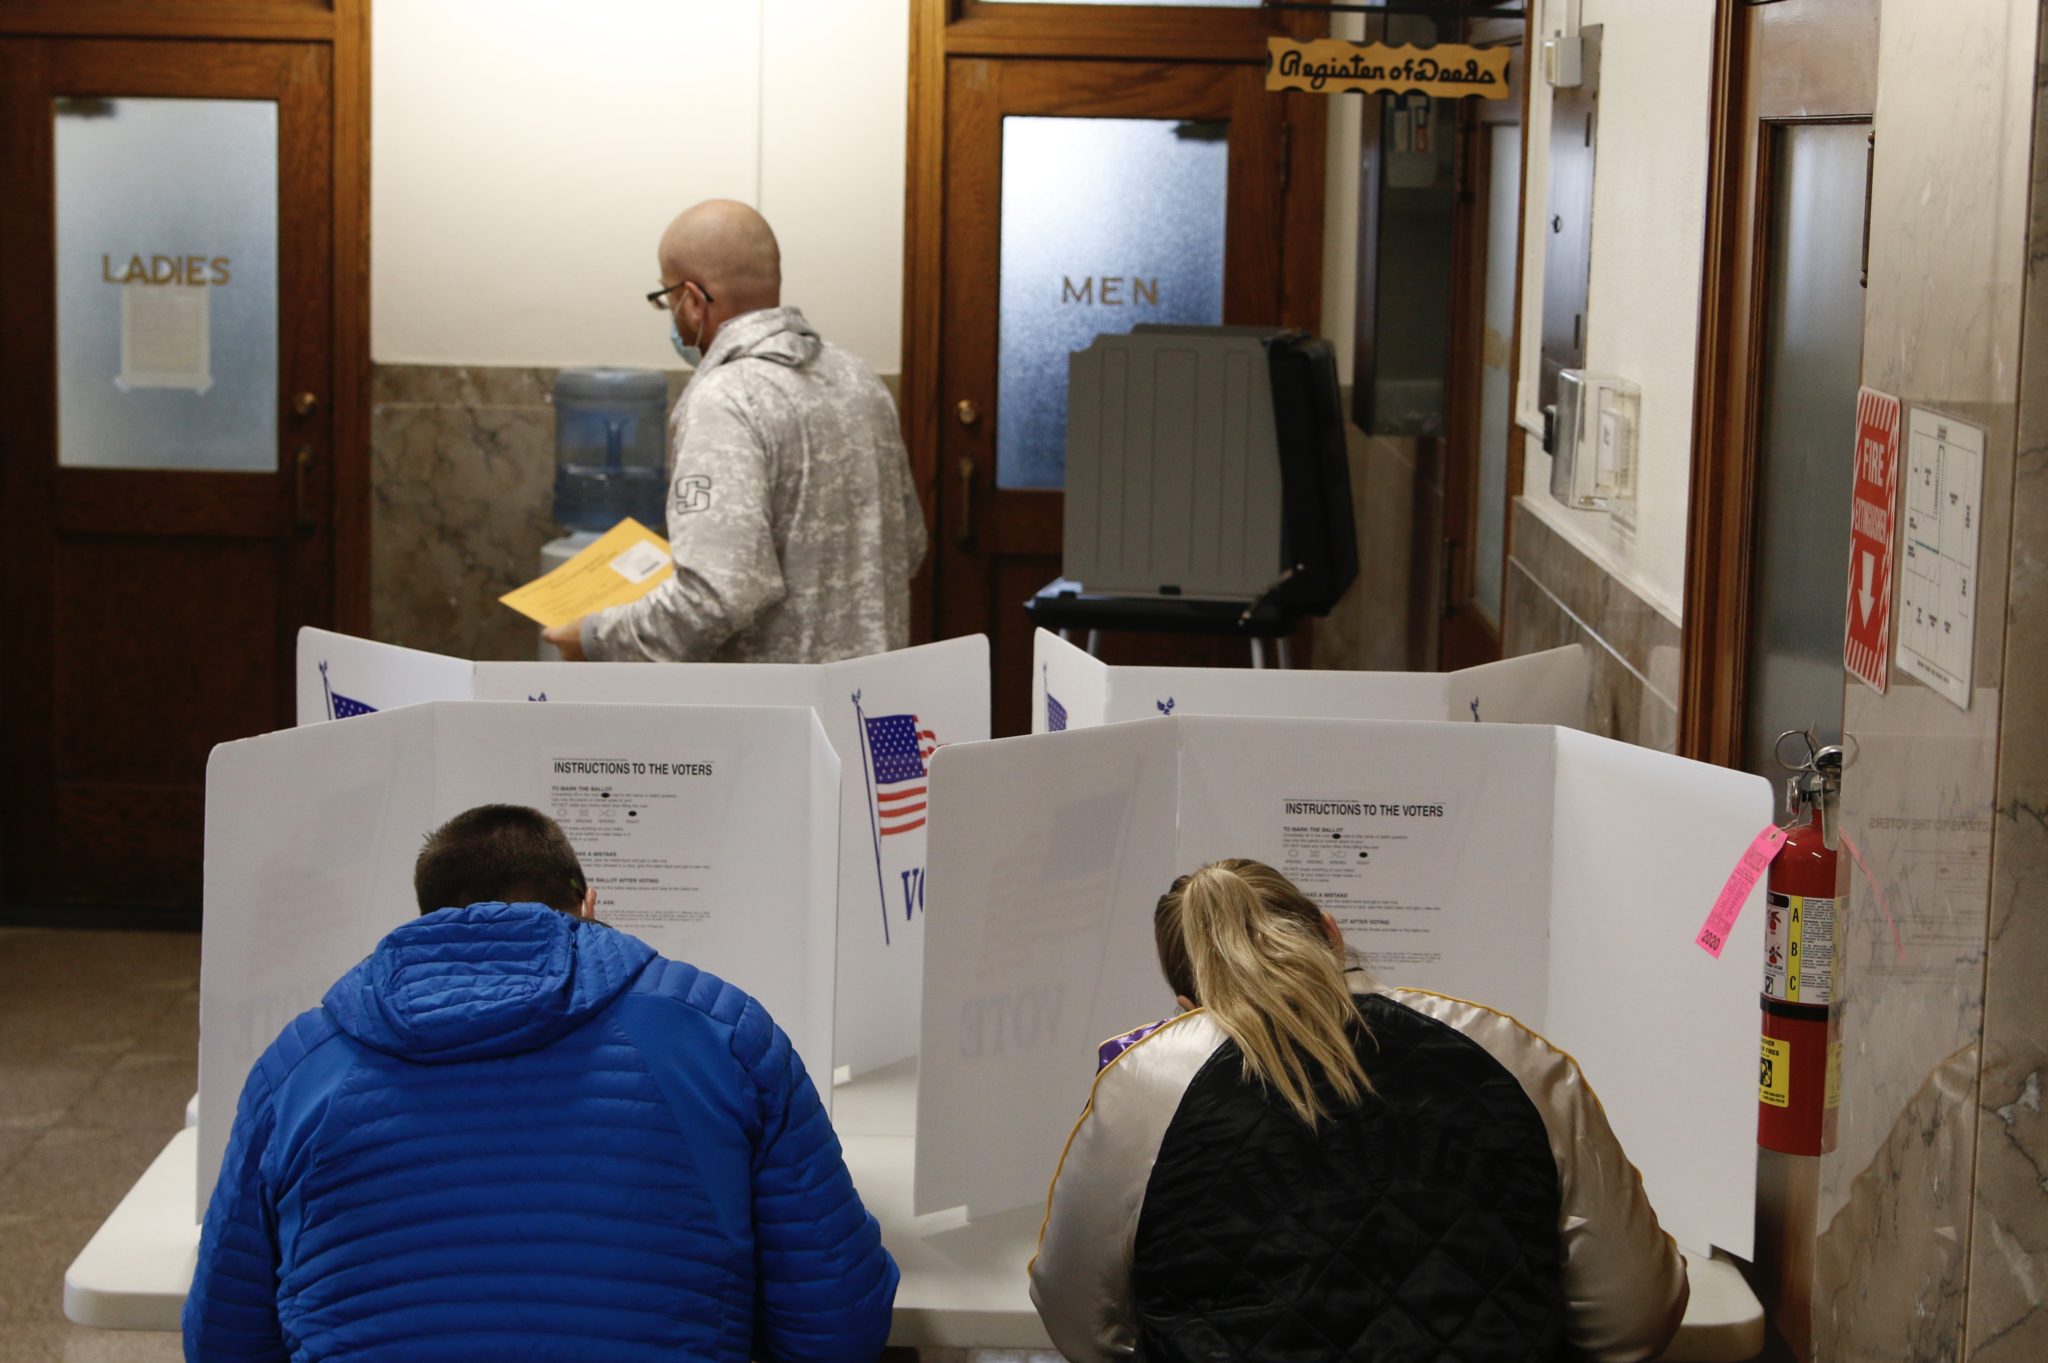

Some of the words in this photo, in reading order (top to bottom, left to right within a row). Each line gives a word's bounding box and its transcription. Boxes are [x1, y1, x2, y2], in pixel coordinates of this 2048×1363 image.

[1279, 49, 1385, 90] Register
[1389, 58, 1415, 81] of
[1414, 57, 1497, 84] Deeds
[102, 254, 231, 286] LADIES
[1061, 275, 1159, 305] MEN
[1863, 438, 1885, 488] FIRE
[553, 762, 630, 775] INSTRUCTIONS
[632, 763, 646, 775] TO
[649, 763, 669, 776] THE
[671, 764, 713, 777] VOTERS
[1285, 802, 1361, 816] INSTRUCTIONS
[1363, 804, 1377, 816] TO
[1380, 804, 1400, 817] THE
[1402, 805, 1444, 817] VOTERS
[901, 866, 925, 921] V
[1792, 907, 1799, 923] A
[1701, 929, 1721, 951] 2020
[1791, 941, 1798, 957] B
[1789, 975, 1796, 991] C
